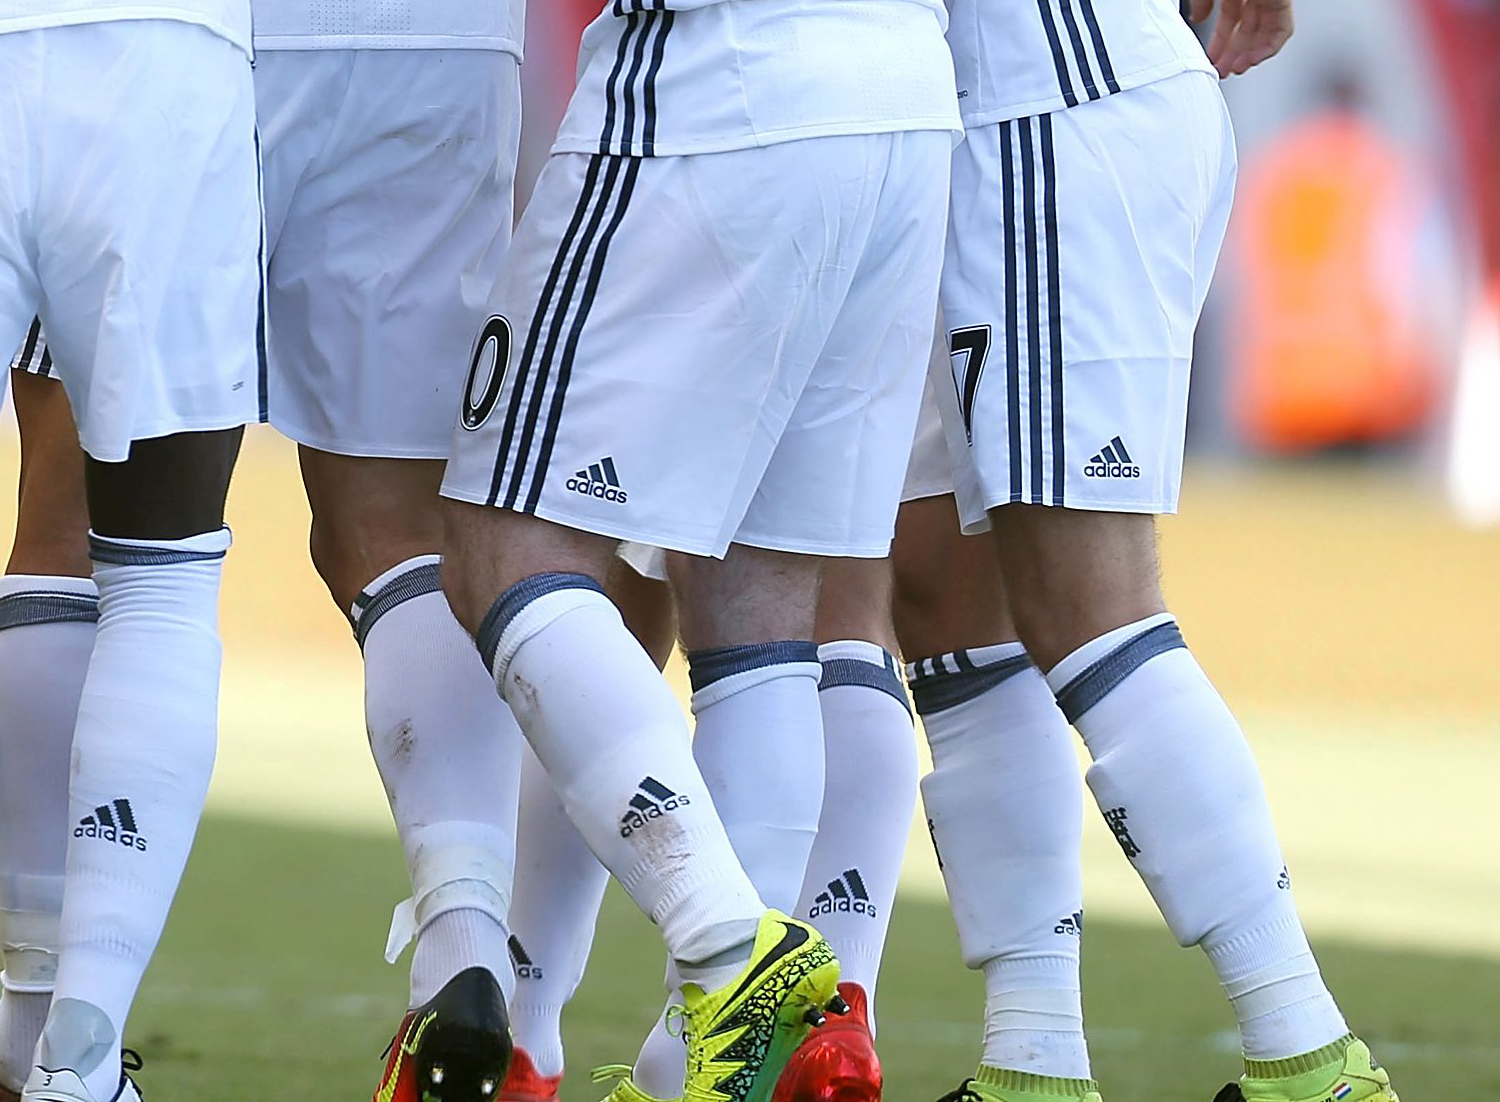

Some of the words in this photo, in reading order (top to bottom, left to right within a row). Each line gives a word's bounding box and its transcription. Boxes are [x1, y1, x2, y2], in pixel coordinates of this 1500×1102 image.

[1084, 462, 1141, 479] adidas
[566, 479, 628, 504] adidas
[620, 794, 691, 838] adidas
[73, 824, 147, 852] adidas
[809, 899, 877, 919] adidas
[42, 1074, 53, 1088] 3
